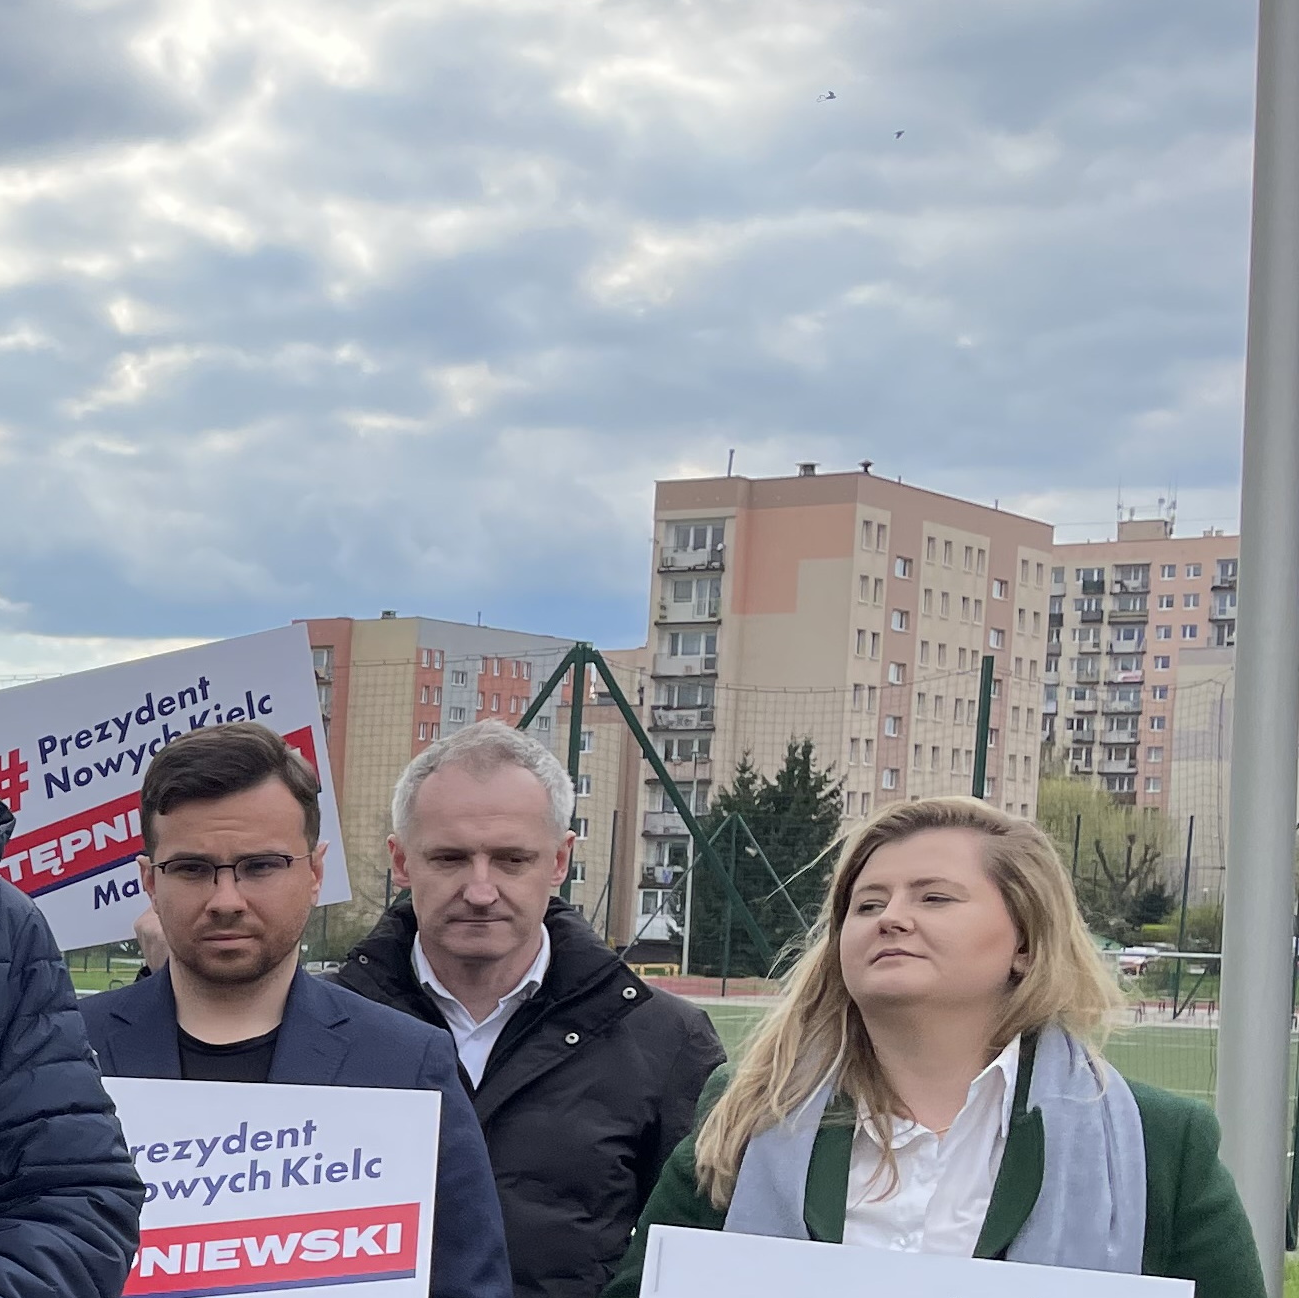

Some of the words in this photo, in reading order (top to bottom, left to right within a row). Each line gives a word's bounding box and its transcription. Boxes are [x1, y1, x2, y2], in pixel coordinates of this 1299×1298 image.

[36, 675, 211, 766] Prezydent
[132, 1120, 317, 1167] rezydent
[144, 1159, 271, 1206] owych
[281, 1147, 382, 1188] Kielc
[131, 1222, 402, 1277] NIEWSKI
